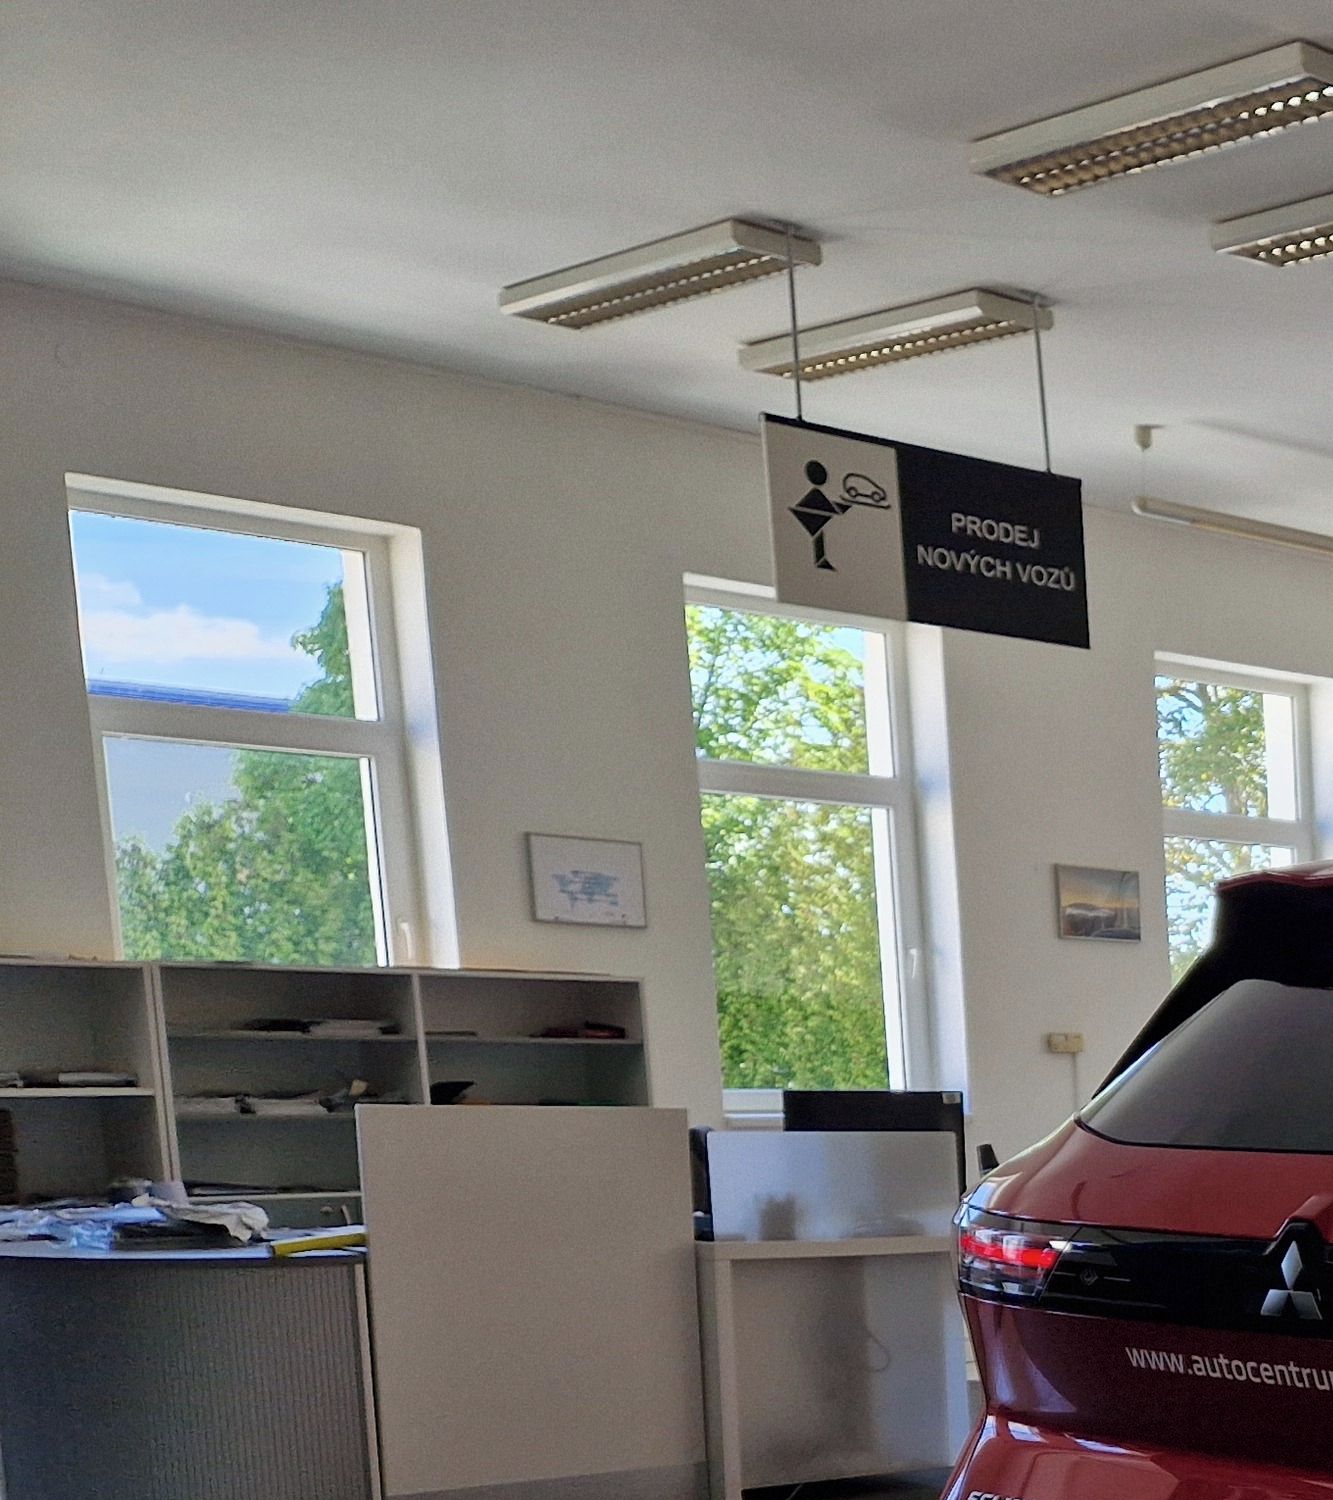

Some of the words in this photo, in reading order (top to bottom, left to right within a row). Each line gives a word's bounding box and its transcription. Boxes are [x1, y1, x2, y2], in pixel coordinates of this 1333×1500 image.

[951, 512, 1041, 548] PRODEJ
[916, 544, 1012, 580] NOVÝCH
[1016, 562, 1075, 592] VOZŮ
